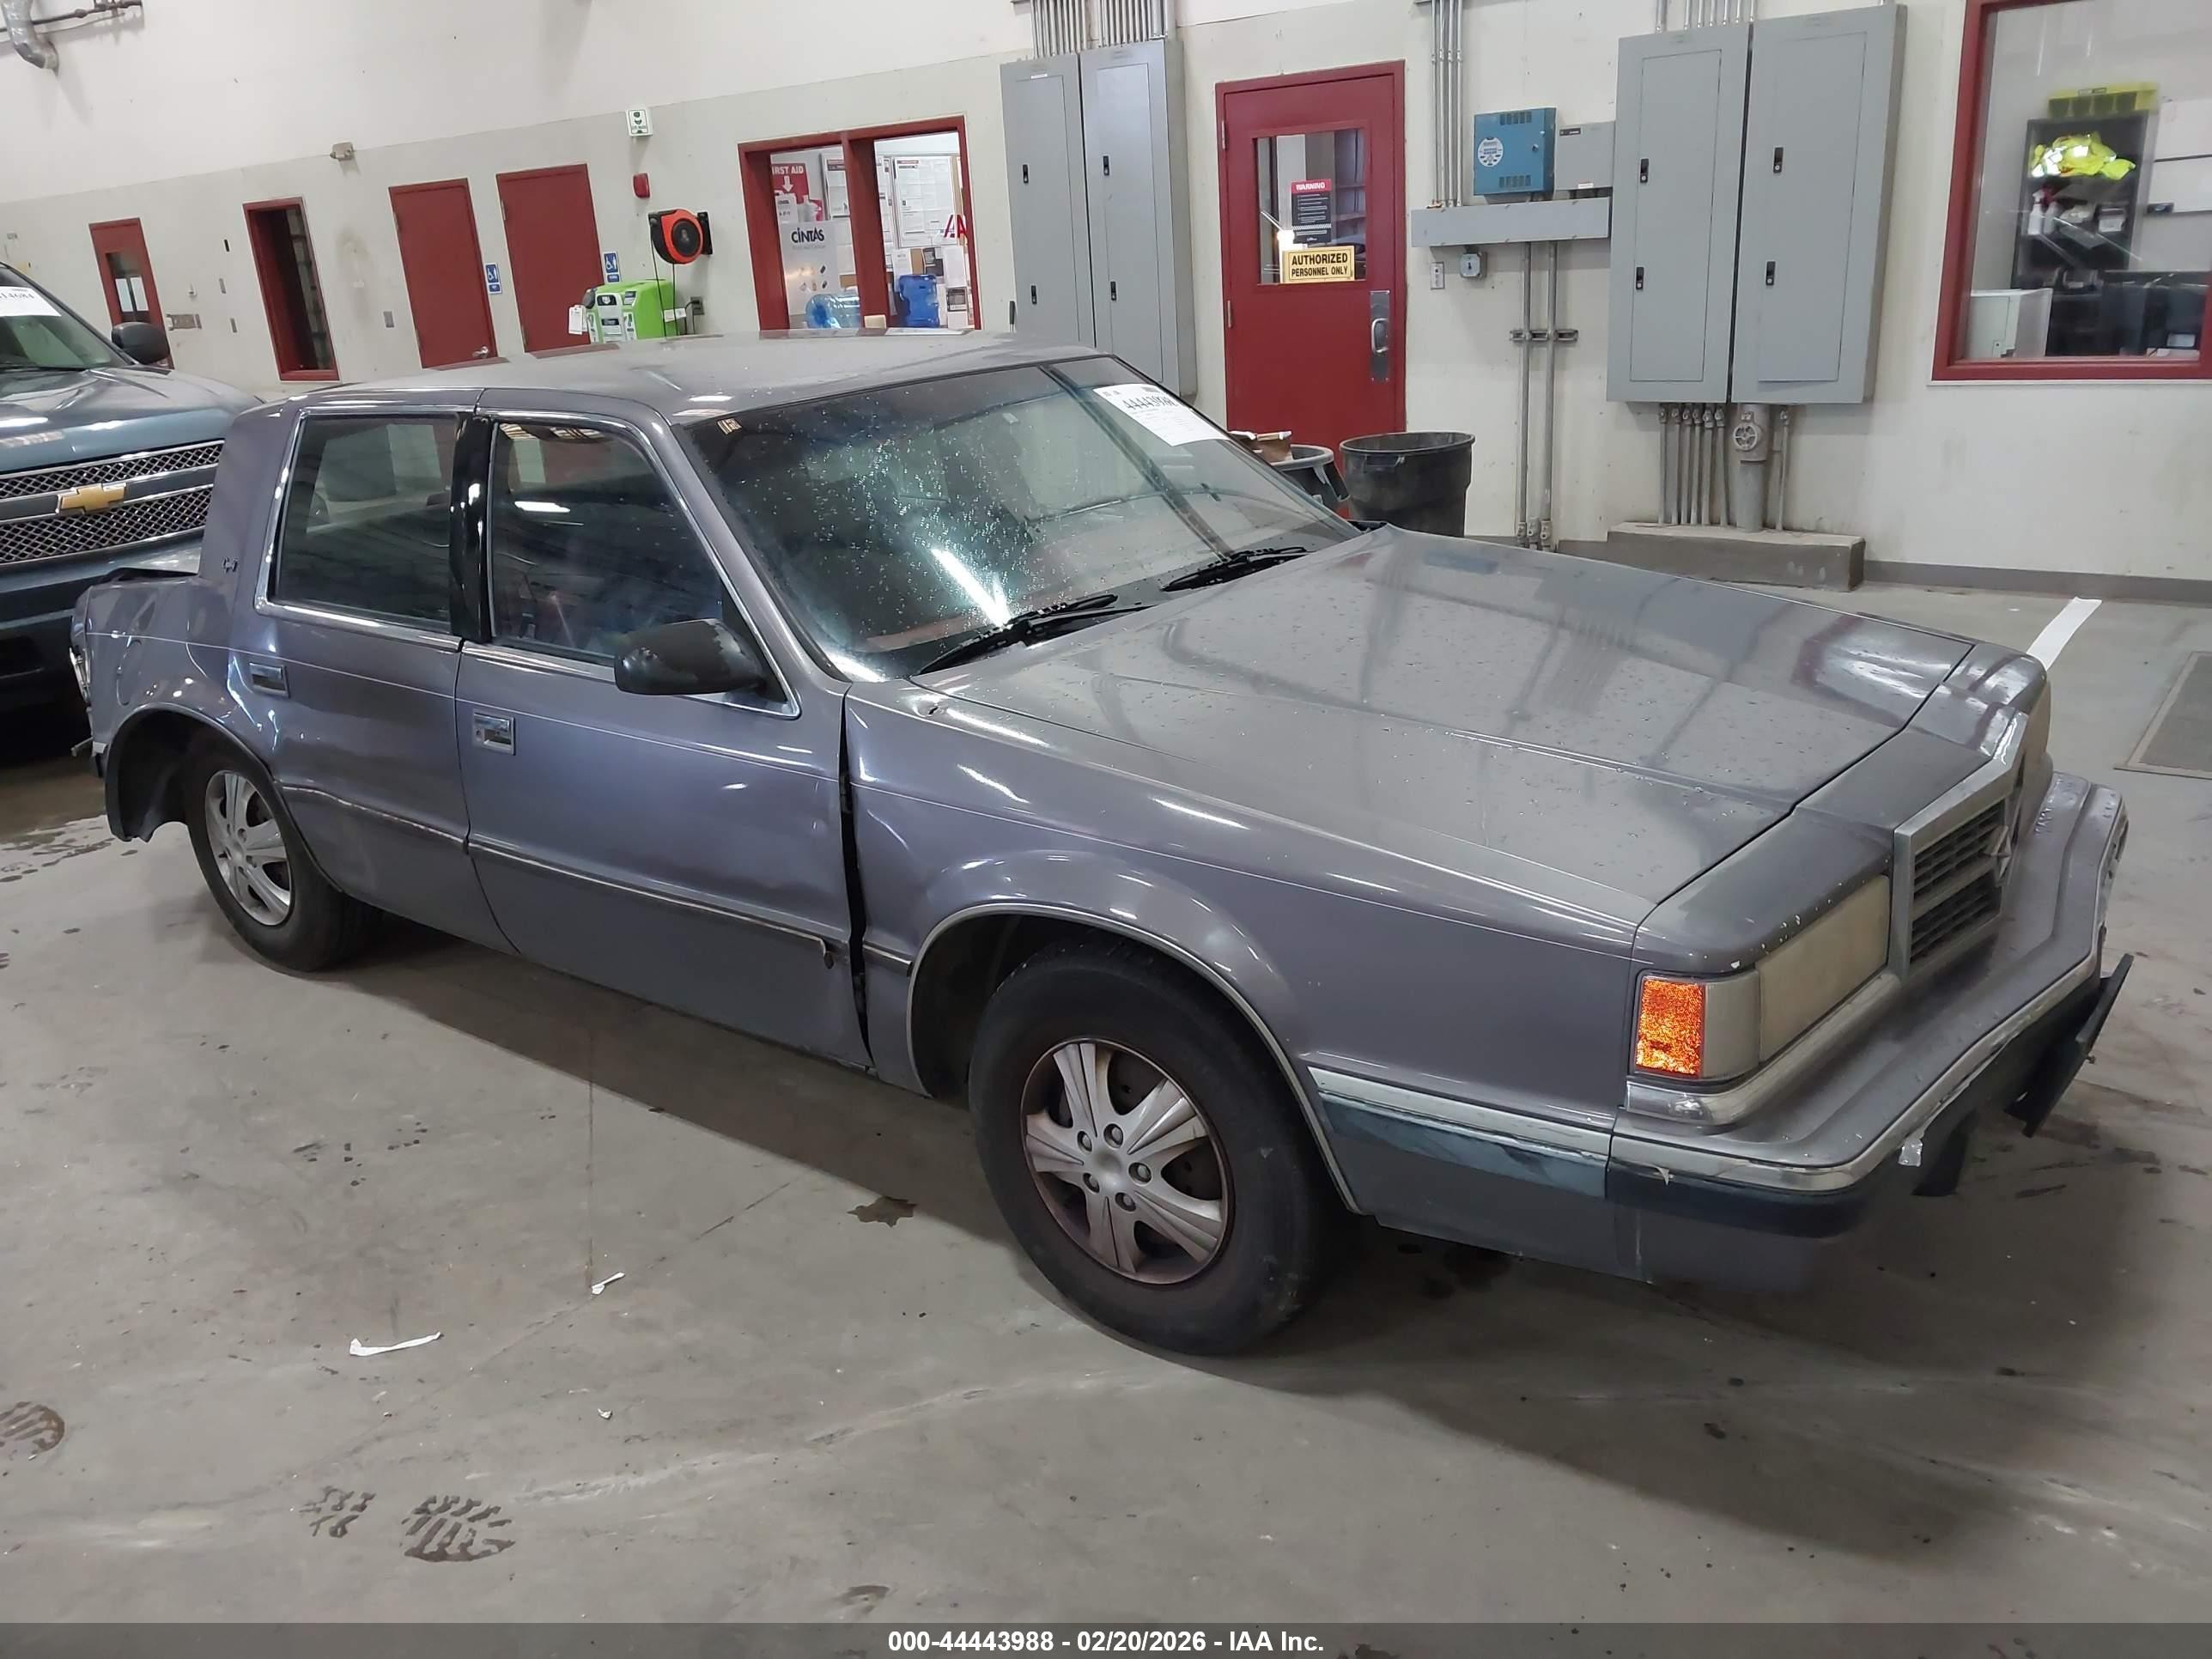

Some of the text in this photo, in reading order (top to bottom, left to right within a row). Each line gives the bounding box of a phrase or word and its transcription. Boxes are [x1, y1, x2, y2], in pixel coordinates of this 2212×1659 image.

[771, 165, 805, 175] IRST AID
[1295, 181, 1326, 191] WARNING
[791, 226, 825, 244] CINTAS
[1291, 252, 1348, 265] AUTHORIZED
[1291, 265, 1348, 276] PERSONNEL ONLY
